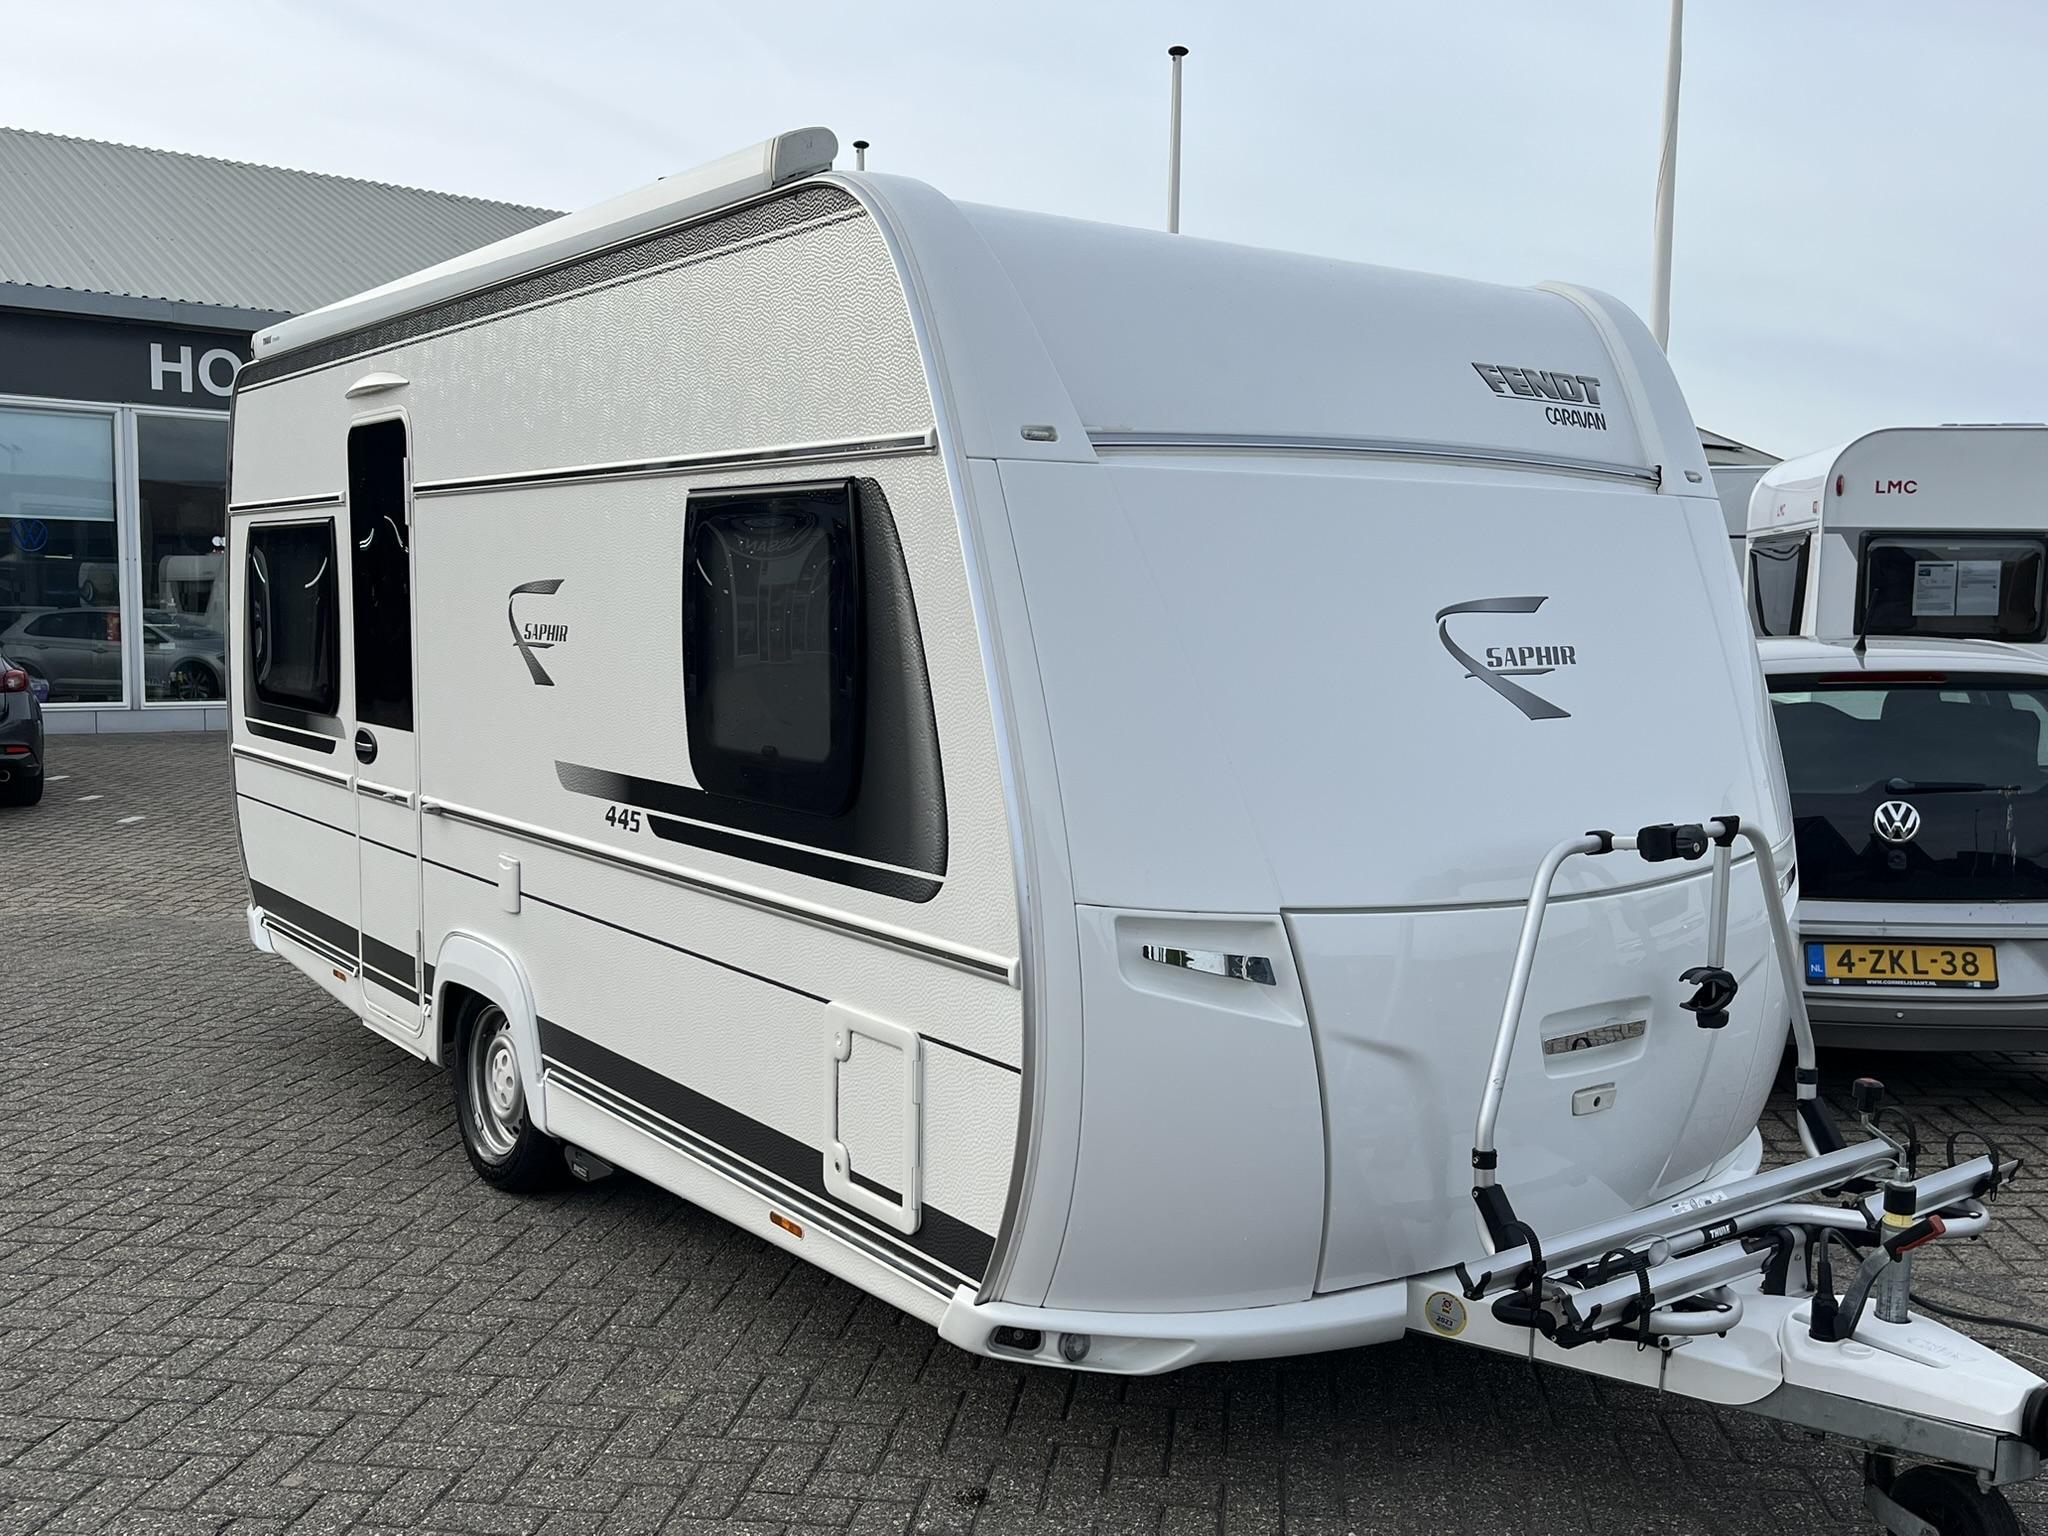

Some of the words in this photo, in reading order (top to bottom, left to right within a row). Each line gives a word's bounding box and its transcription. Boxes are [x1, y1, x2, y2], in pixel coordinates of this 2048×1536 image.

[1471, 362, 1601, 405] FENDT
[1545, 406, 1607, 431] CARAVAN
[1875, 480, 1918, 494] LMC
[524, 623, 568, 642] SAPHIR
[1486, 645, 1577, 667] SAPHIR
[604, 806, 641, 833] 445
[1810, 964, 1824, 973] NL
[1836, 948, 1980, 977] 4-ZKL-38
[1709, 1224, 1730, 1239] THULE
